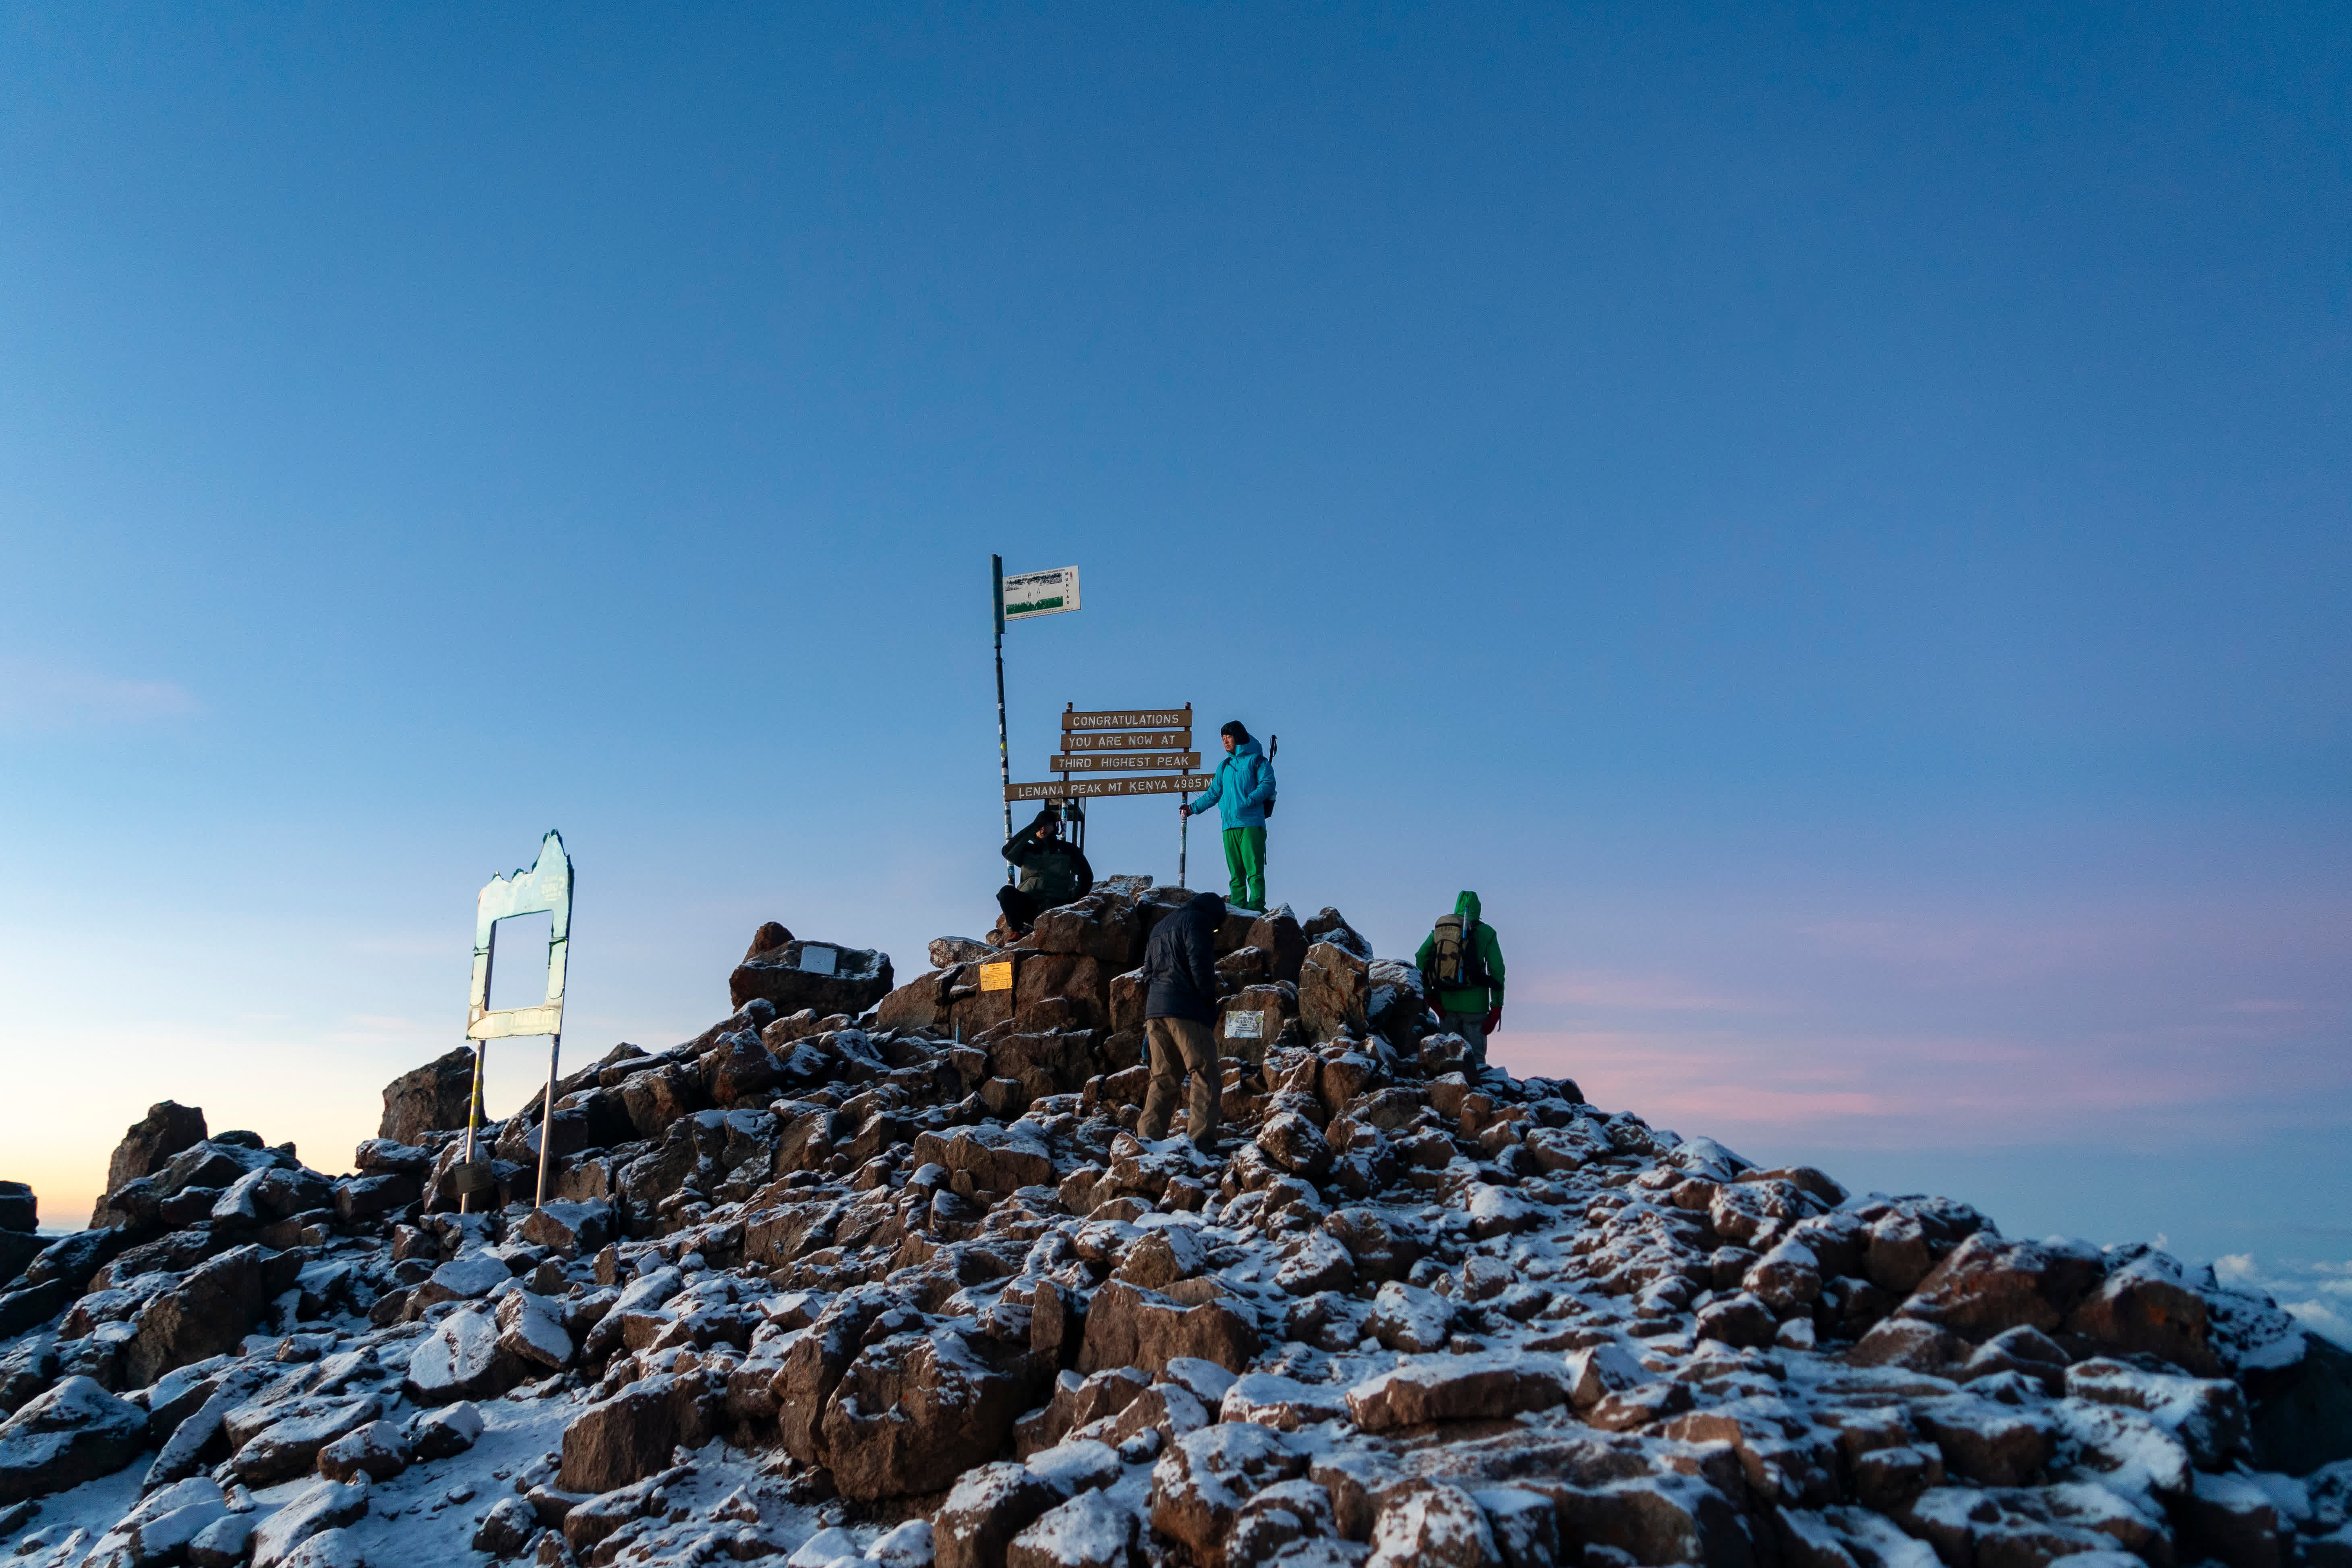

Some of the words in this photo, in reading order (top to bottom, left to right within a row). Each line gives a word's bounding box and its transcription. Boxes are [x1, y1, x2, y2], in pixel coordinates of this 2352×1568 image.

[1073, 714, 1179, 727] CONGRATULATIONS
[1069, 737, 1091, 747] YOU
[1098, 736, 1122, 747] ARE
[1128, 735, 1153, 746] NOW
[1161, 735, 1176, 745] AT
[1059, 758, 1091, 768] THIRD
[1101, 757, 1150, 767] HIGHEST
[1157, 756, 1189, 766] PEAK
[1018, 786, 1064, 799] LENANA
[1070, 783, 1101, 795] PEAK
[1108, 782, 1122, 792] MT
[1129, 780, 1167, 793] KENYA
